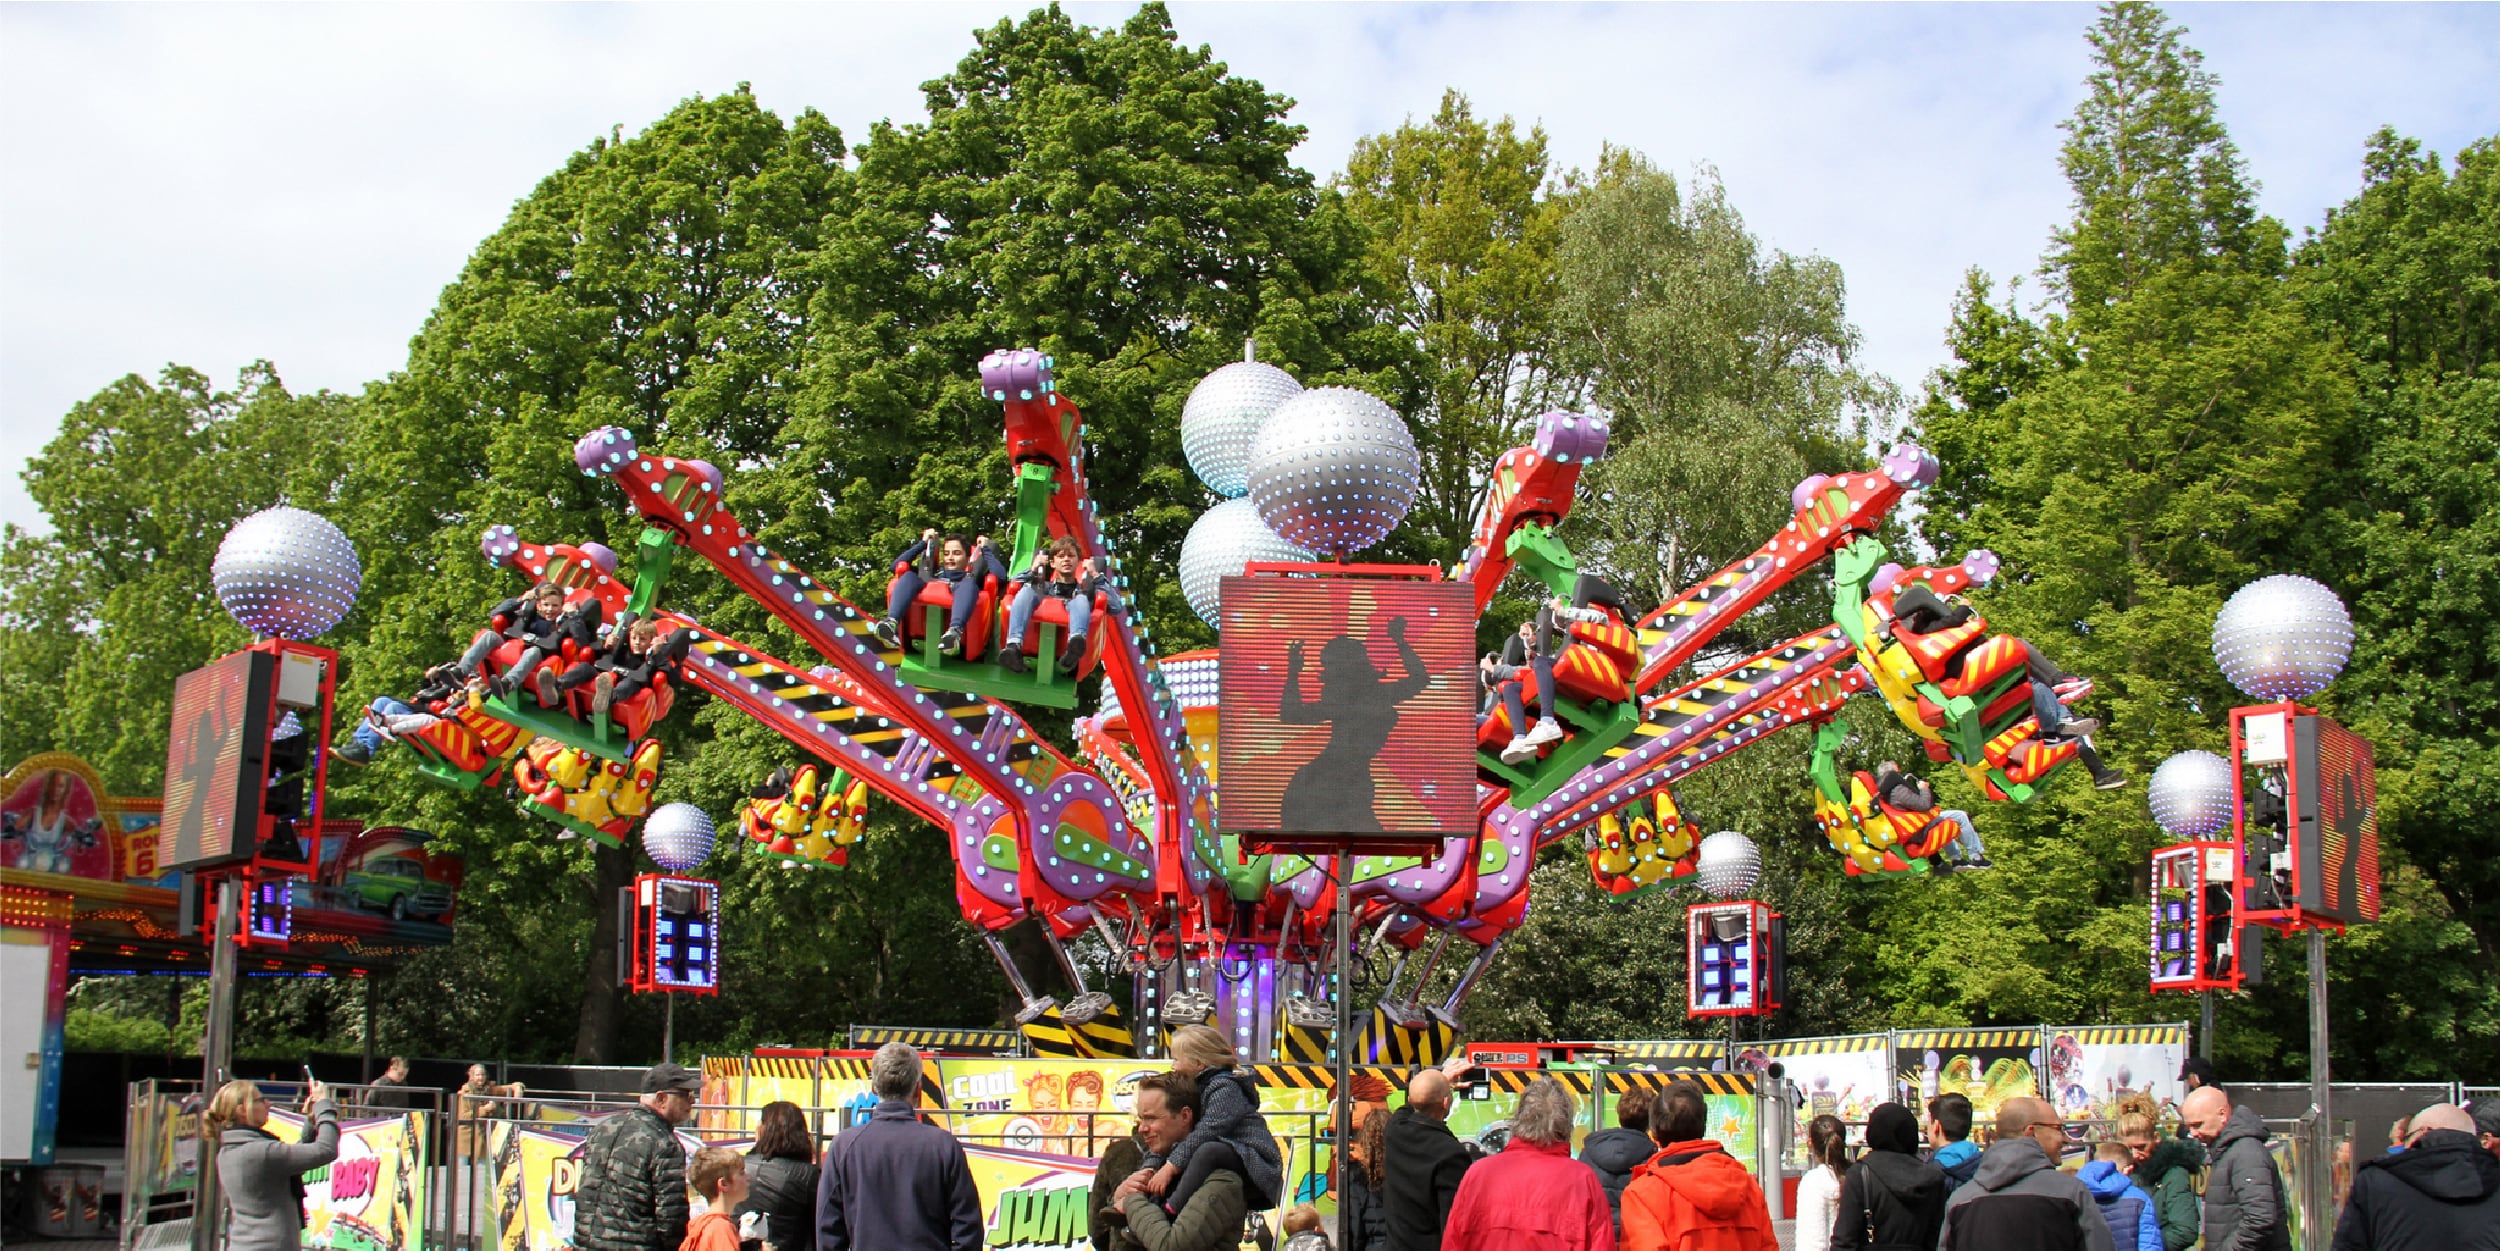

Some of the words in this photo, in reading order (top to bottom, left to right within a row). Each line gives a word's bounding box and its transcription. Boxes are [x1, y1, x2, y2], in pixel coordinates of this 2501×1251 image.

[952, 1070, 1018, 1100] COOL
[1111, 1081, 1139, 1096] DISC
[963, 1098, 1012, 1117] ZONE
[332, 1157, 380, 1202] BABY
